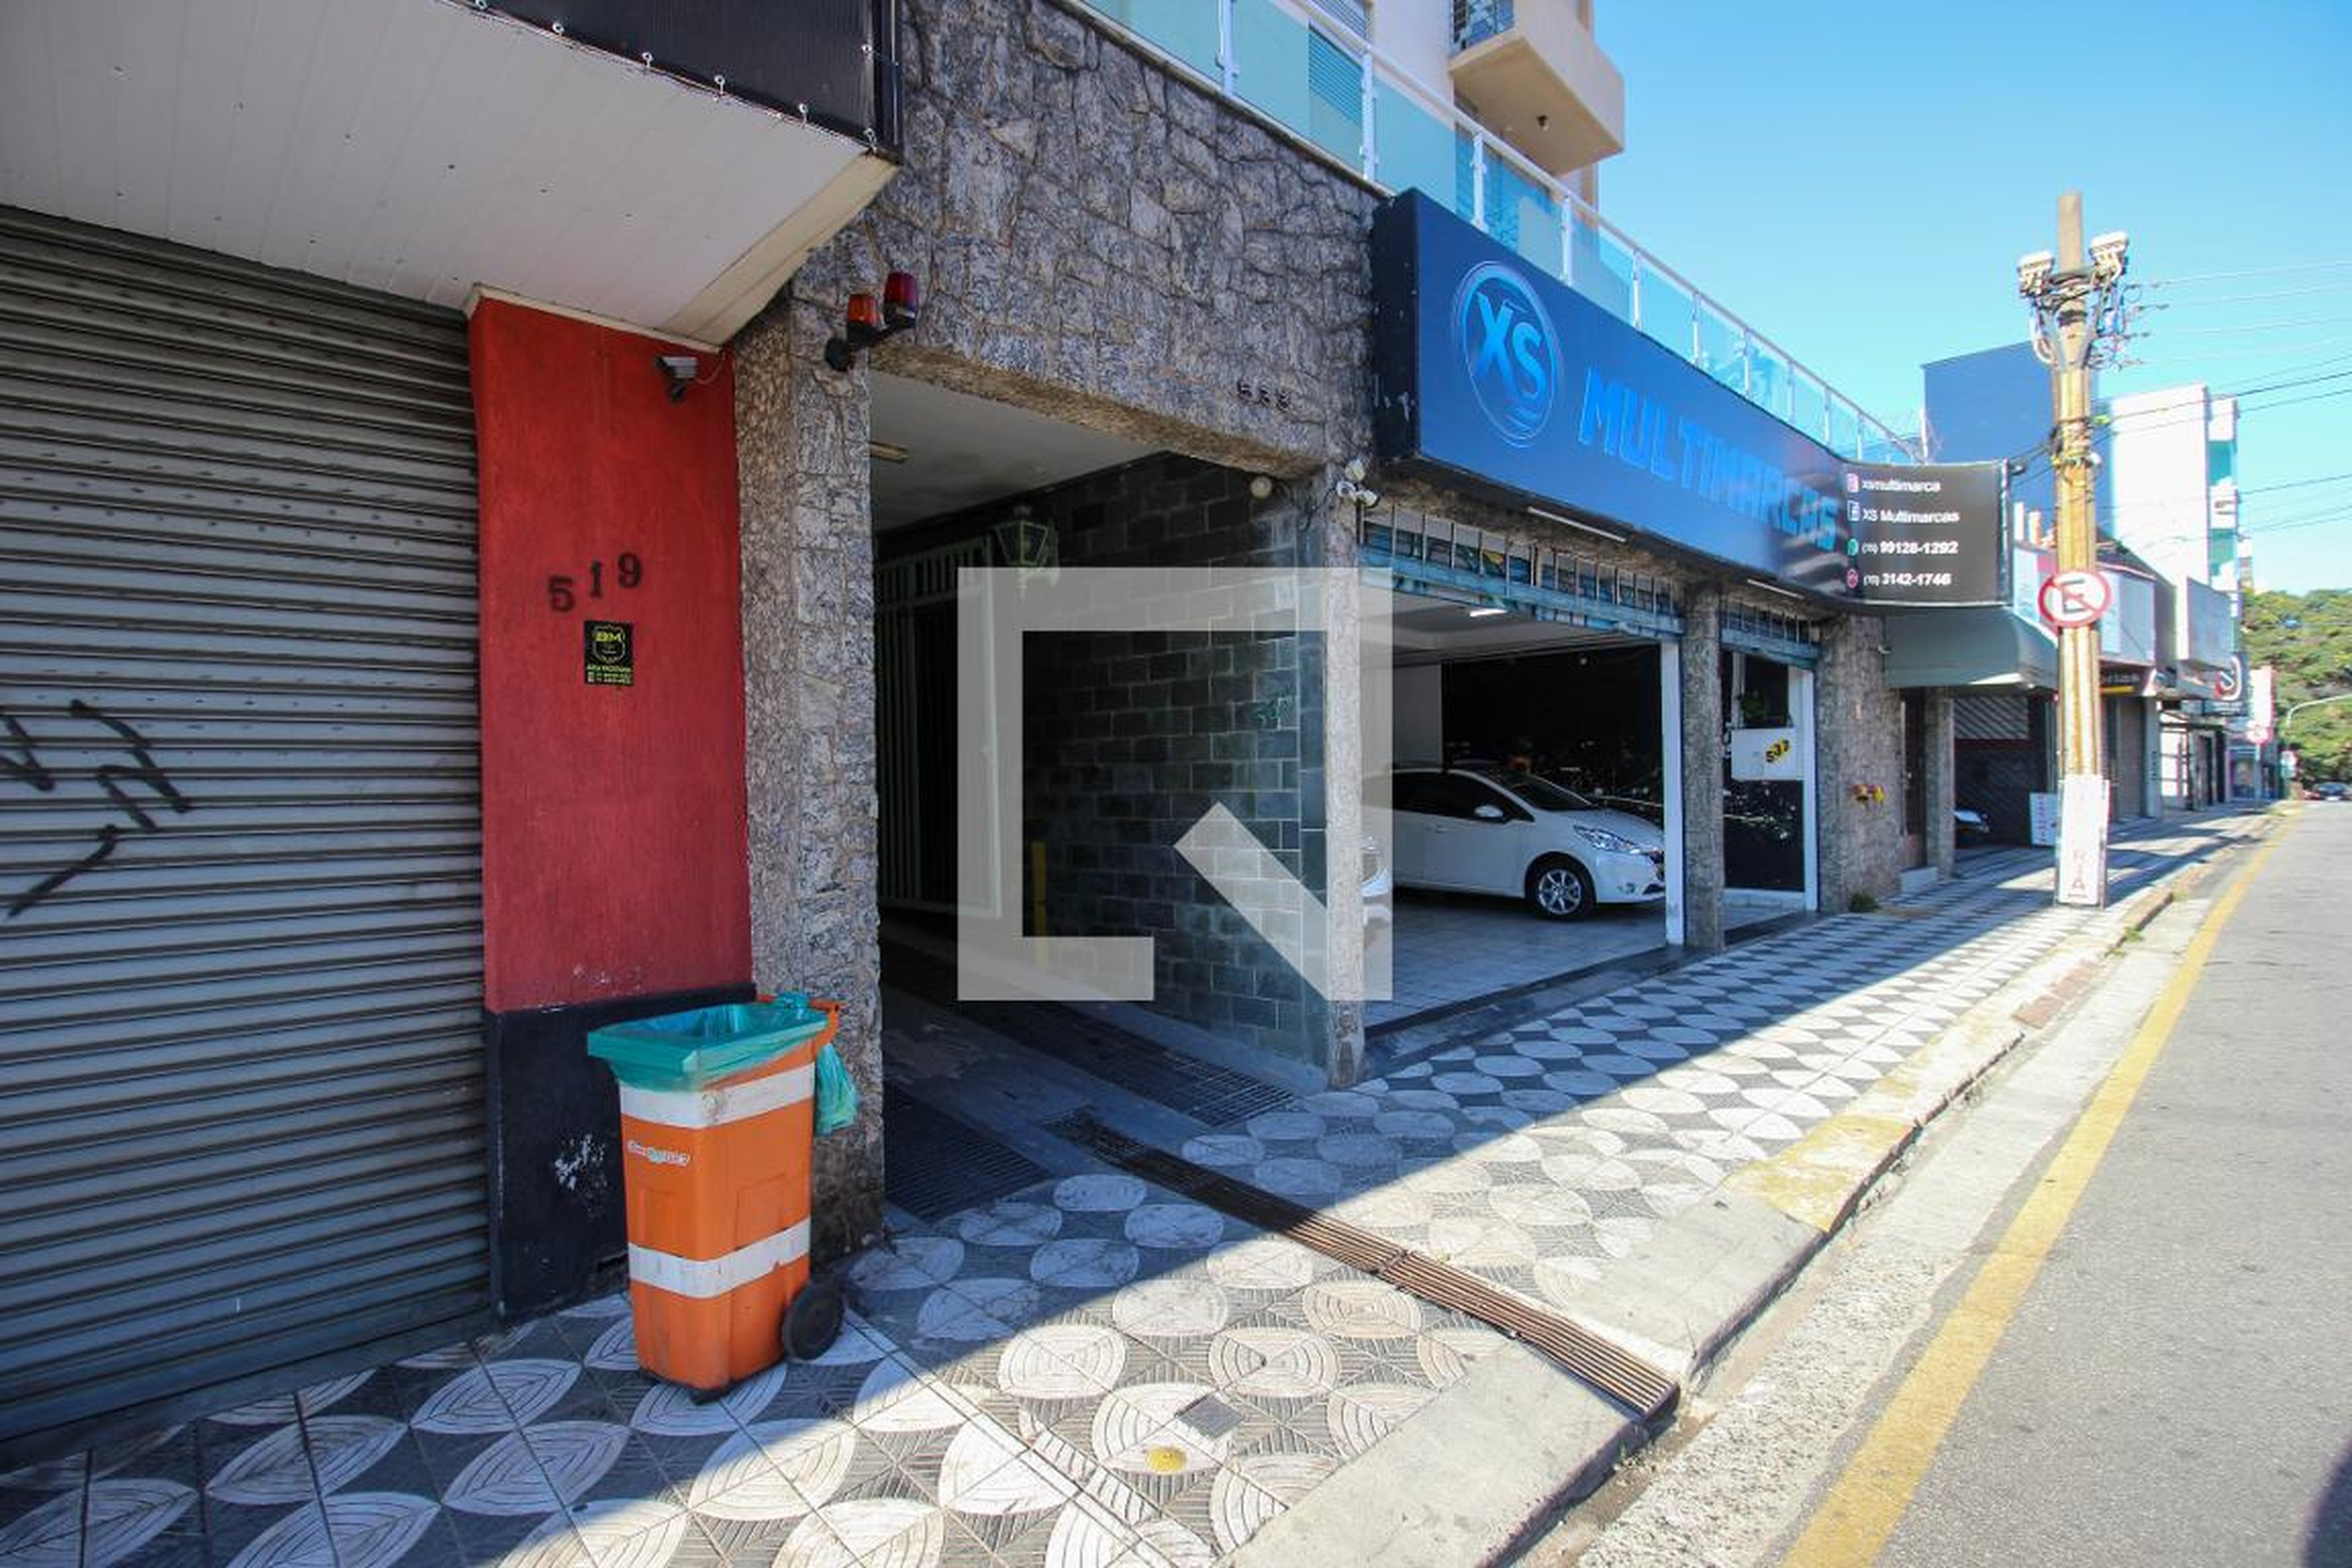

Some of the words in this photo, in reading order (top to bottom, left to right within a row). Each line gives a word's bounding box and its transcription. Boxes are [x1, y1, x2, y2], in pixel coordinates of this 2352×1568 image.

[1475, 292, 1548, 404] XS
[1578, 366, 1838, 551] MULTIMARCAS
[1863, 508, 1879, 521] XS
[1880, 509, 1960, 523] Multimarcas
[548, 551, 643, 612] 519
[1765, 739, 1790, 763] 537
